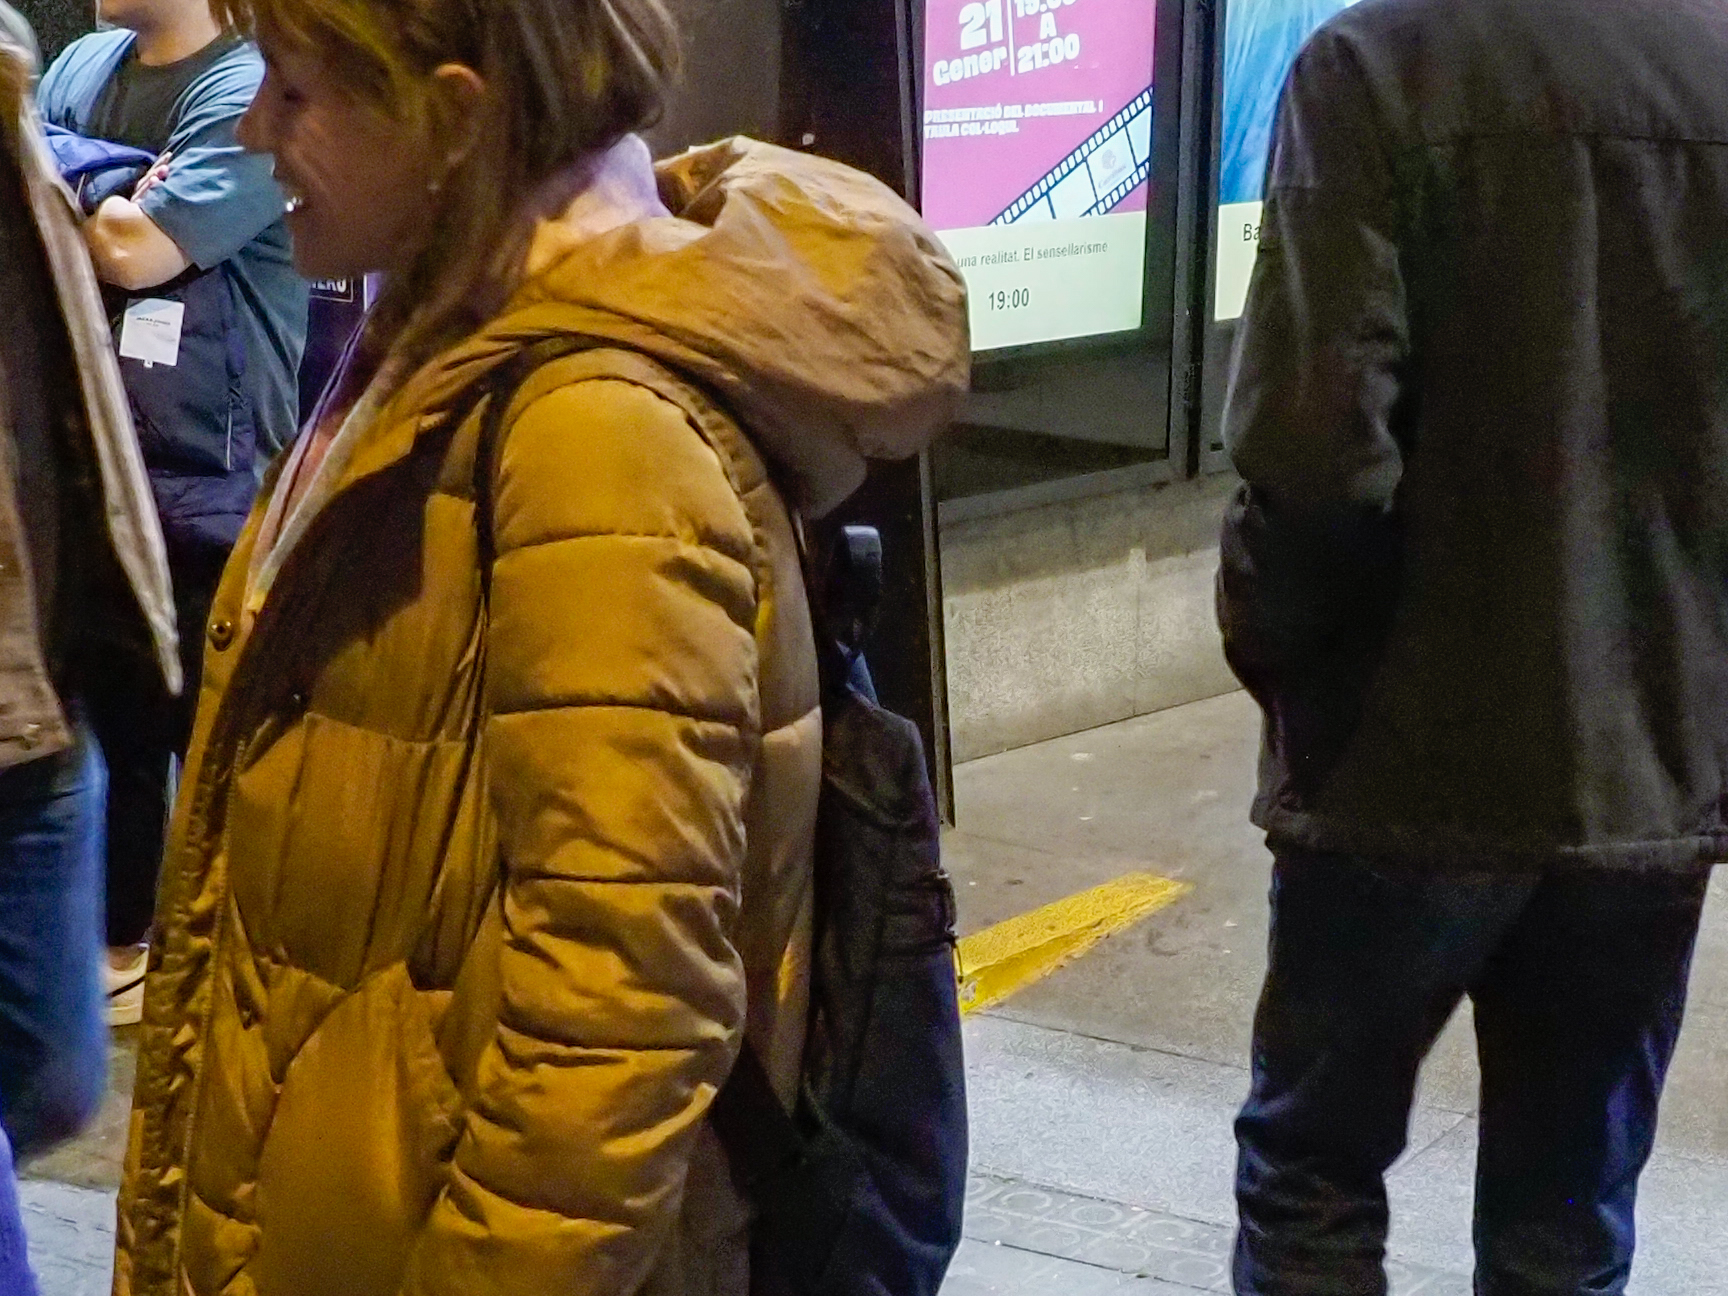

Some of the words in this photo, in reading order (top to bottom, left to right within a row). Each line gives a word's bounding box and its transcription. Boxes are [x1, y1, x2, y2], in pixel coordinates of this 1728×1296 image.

[1040, 11, 1057, 39] A
[933, 46, 1007, 86] Gener
[1017, 33, 1081, 74] 21:00
[1036, 240, 1108, 259] sensellarisme
[988, 288, 1031, 311] 19:00
